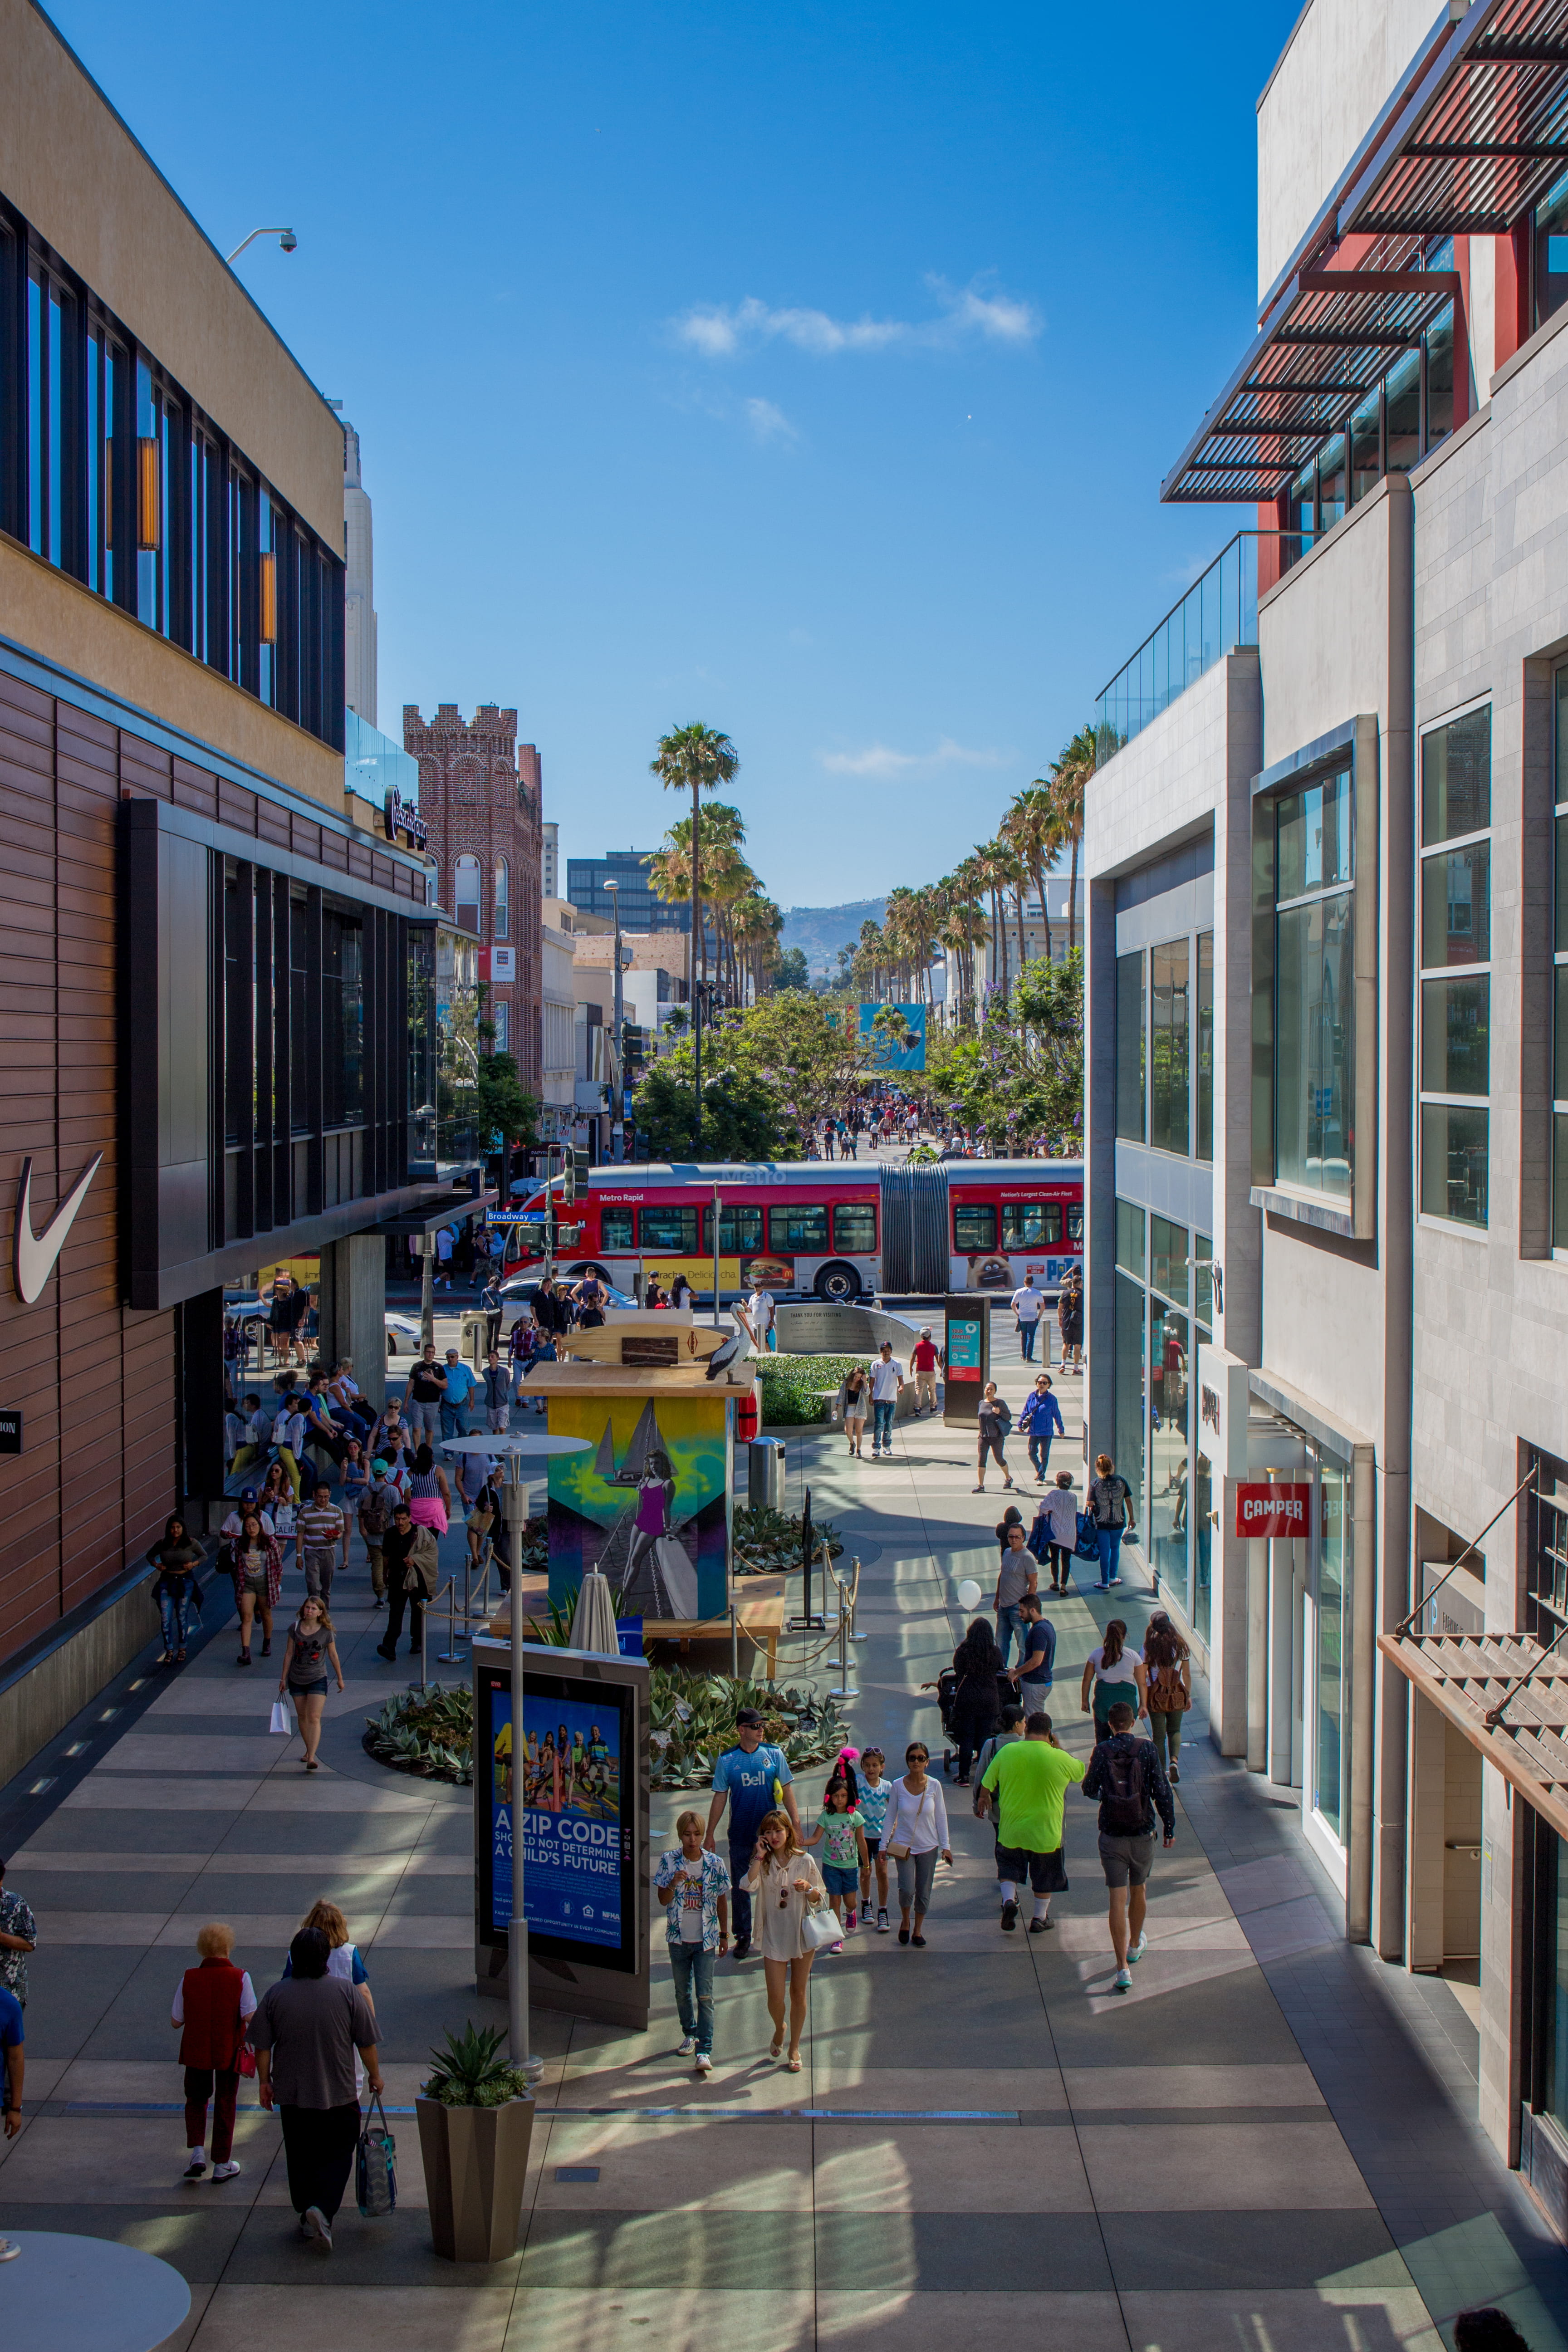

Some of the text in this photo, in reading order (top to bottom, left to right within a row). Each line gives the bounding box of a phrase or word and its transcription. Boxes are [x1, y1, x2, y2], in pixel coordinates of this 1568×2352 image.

[721, 1168, 787, 1184] Metro
[488, 1213, 529, 1221] Broadway
[1244, 1499, 1303, 1521] CAMPER
[741, 1770, 765, 1787] Bell
[495, 1809, 620, 1848] A ZIP CODE
[495, 1831, 620, 1861] SHOLD NOT DETERMINE
[495, 1843, 505, 1857] A
[564, 1854, 620, 1876] FUTURE.
[544, 1919, 573, 1928] OPPORTUNITY
[594, 1928, 620, 1937] COMMUNITY.
